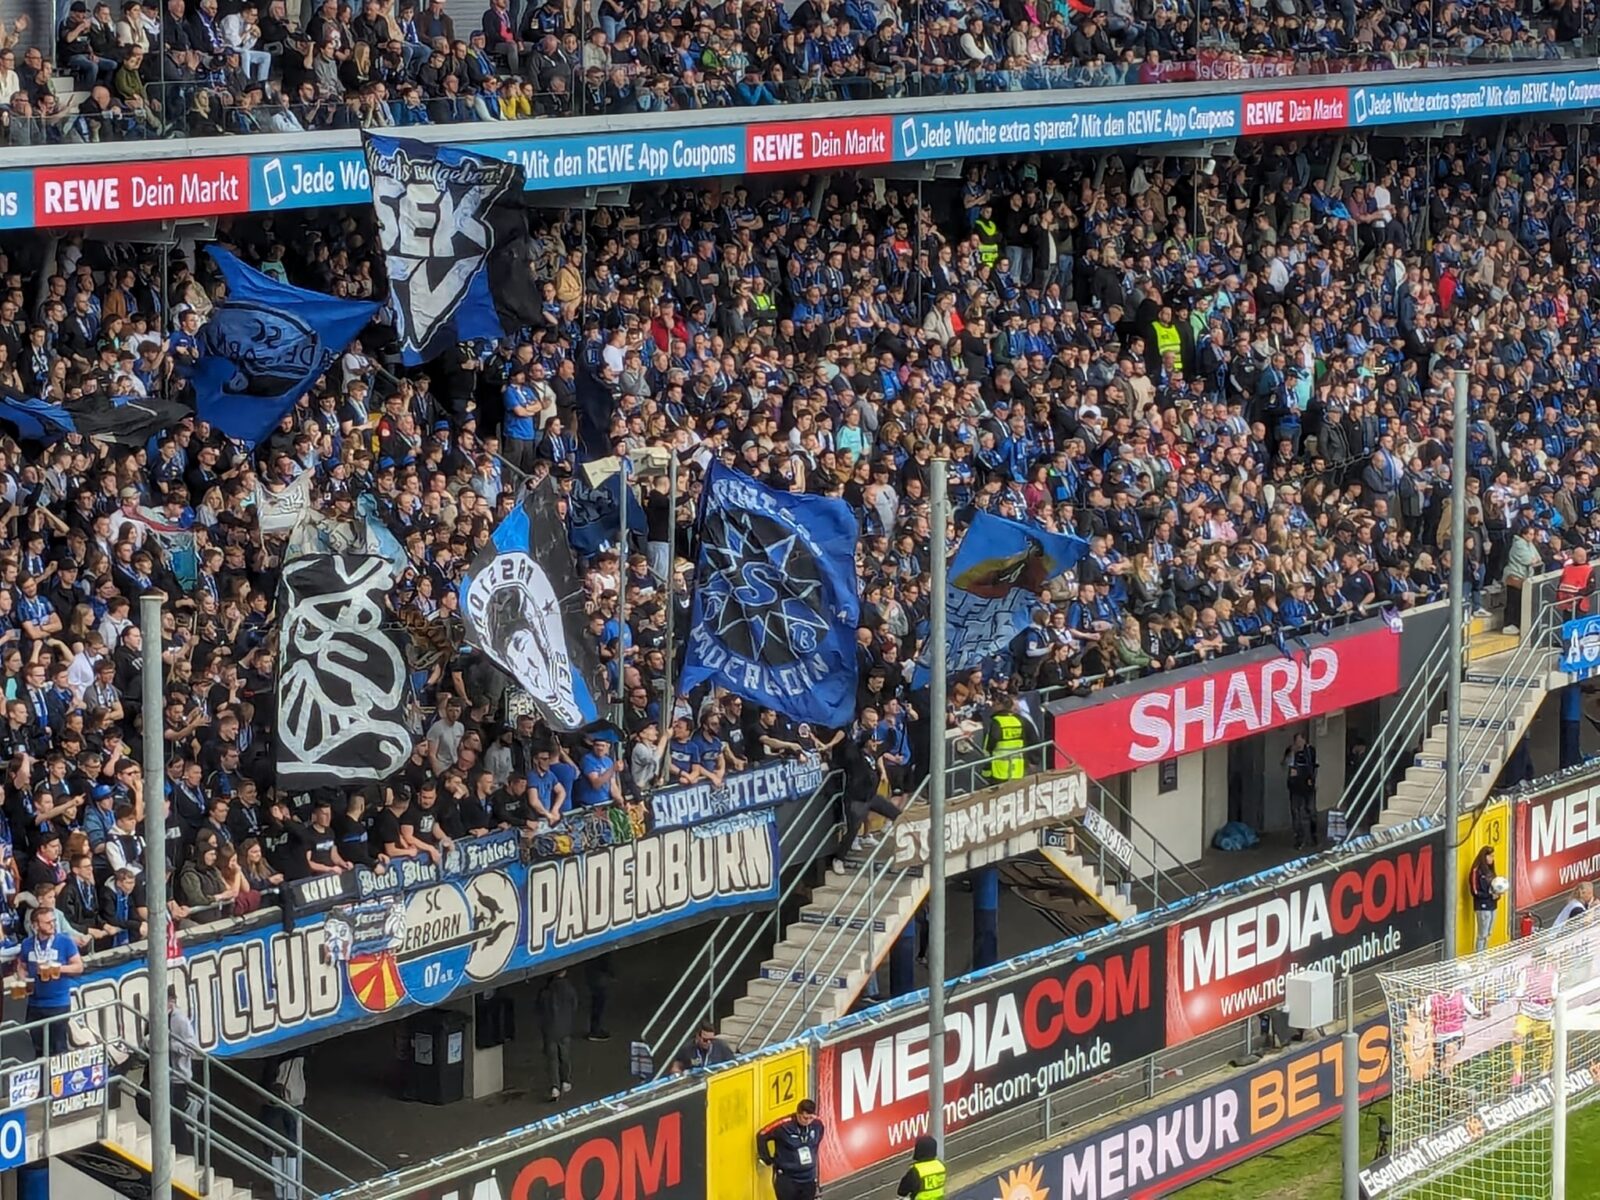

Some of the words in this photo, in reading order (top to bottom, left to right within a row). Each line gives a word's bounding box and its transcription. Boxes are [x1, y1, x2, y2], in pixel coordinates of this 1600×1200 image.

[1246, 101, 1284, 126] REWE
[1289, 99, 1312, 123] Dein
[1313, 97, 1343, 120] Markt
[1368, 92, 1391, 116] Jede
[1393, 90, 1424, 113] Woche
[1425, 93, 1450, 112] extra
[1451, 85, 1485, 114] sparen?
[1486, 85, 1503, 107] Mit
[1504, 84, 1521, 106] den
[1522, 82, 1549, 104] REWE
[1550, 80, 1567, 107] App
[1568, 79, 1600, 105] Coupon
[753, 132, 804, 162] REWE
[811, 131, 841, 158] Dein
[845, 127, 885, 155] Markt
[921, 121, 951, 148] Jede
[954, 118, 996, 147] Woche
[1000, 119, 1030, 143] extra
[1034, 112, 1080, 146] sparen?
[1081, 113, 1101, 138] Mit
[1104, 112, 1125, 137] den
[1127, 109, 1162, 135] REWE
[1164, 108, 1186, 137] App
[1188, 106, 1235, 134] Coupons
[291, 163, 334, 195] Jede
[522, 149, 549, 179] Mit
[554, 148, 582, 176] den
[587, 143, 634, 174] REWE
[638, 142, 668, 177] App
[672, 139, 736, 174] Coupons
[44, 178, 120, 213] REWE
[132, 175, 175, 208] Dein
[180, 171, 239, 204] Markt
[1128, 646, 1339, 762] SHARP
[1486, 820, 1500, 845] 13
[425, 888, 441, 914] SC
[529, 825, 772, 954] PADERBORN
[398, 912, 462, 949] ERBORN
[1182, 844, 1433, 992] MEDIACOM
[424, 962, 441, 988] 07
[840, 945, 1151, 1122] MEDIACOM
[771, 1071, 794, 1104] 12
[887, 1035, 1112, 1147] wwwmediacom-gmbh.de
[1478, 1083, 1551, 1131] Eisenbach
[1540, 1068, 1594, 1101] Tsore
[1061, 1088, 1241, 1200] MERKUR
[1250, 1025, 1392, 1135] BETS
[0, 1119, 23, 1159] 0
[442, 1111, 682, 1200] COM
[1359, 1144, 1429, 1199] Eisenbach
[1417, 1123, 1473, 1165] Tresore
